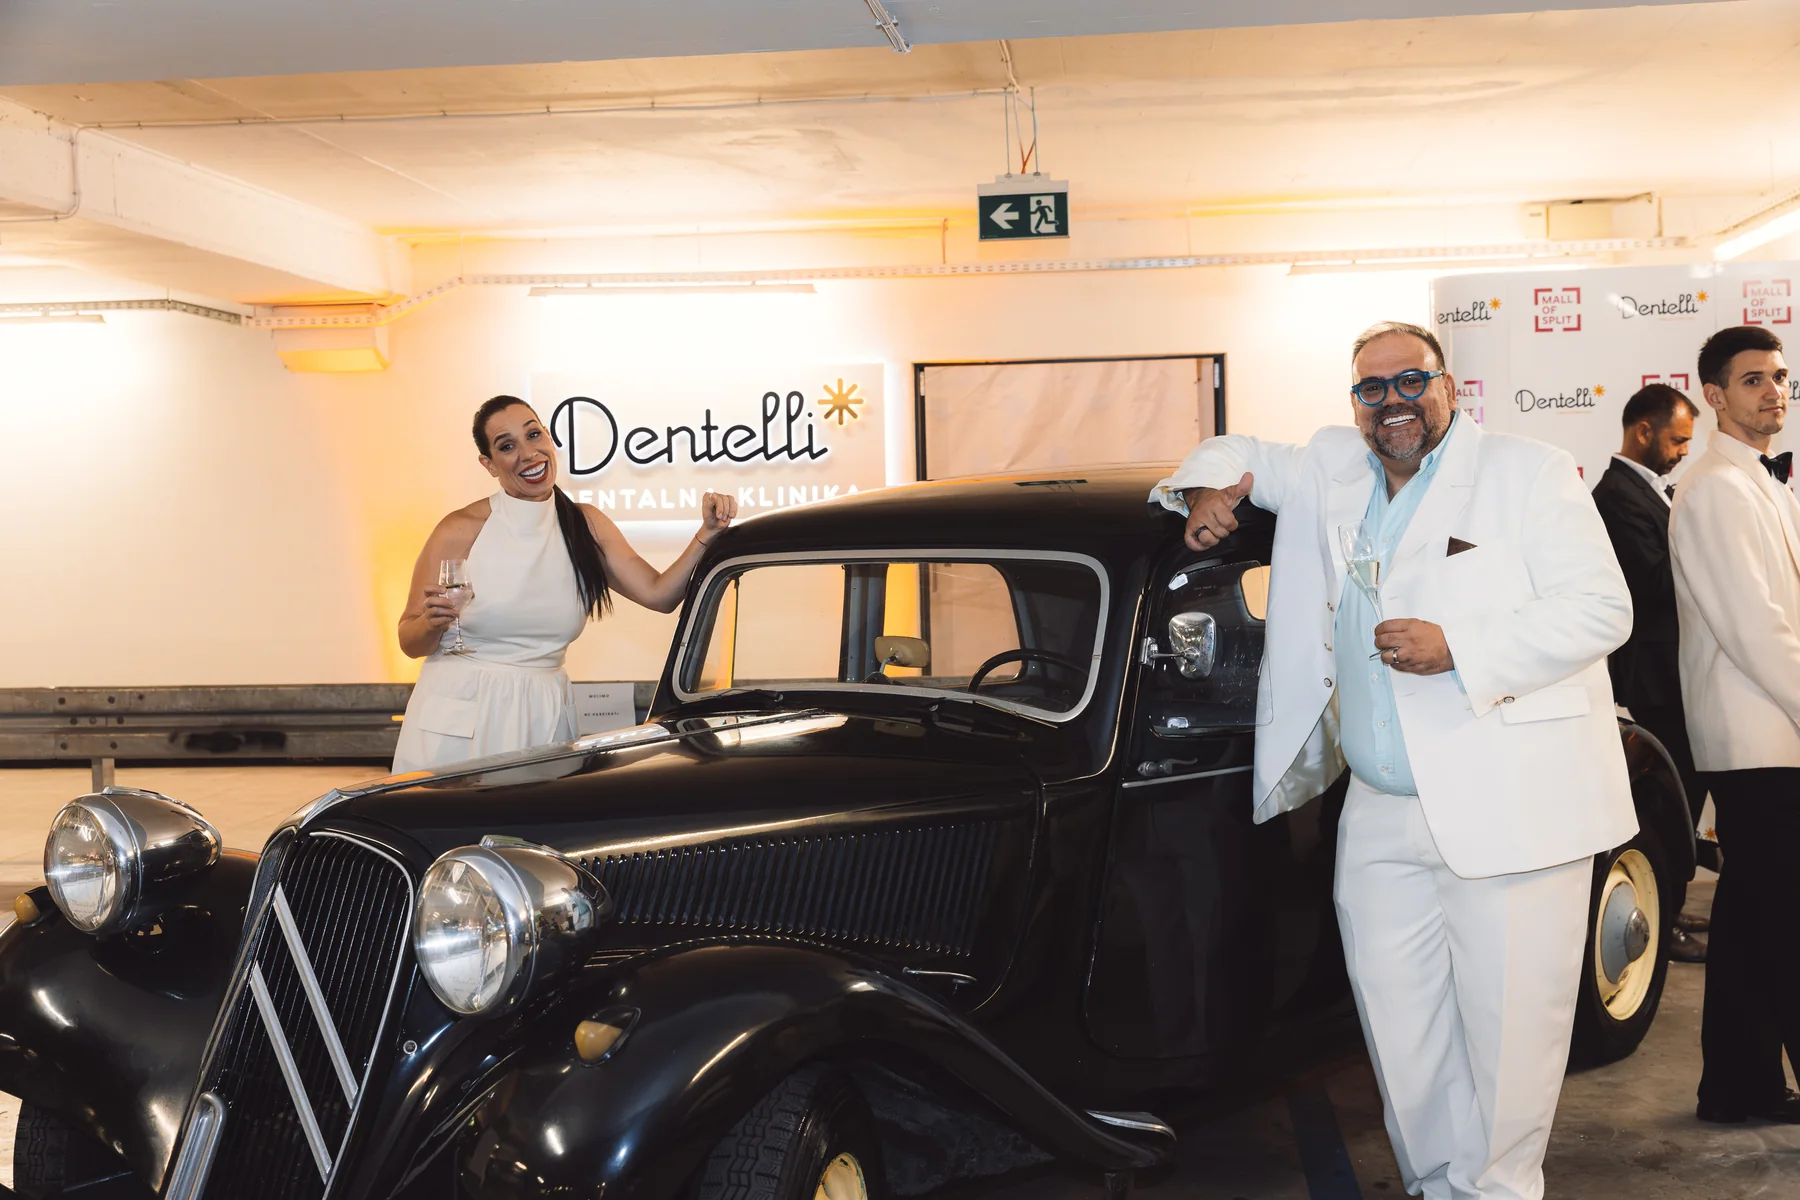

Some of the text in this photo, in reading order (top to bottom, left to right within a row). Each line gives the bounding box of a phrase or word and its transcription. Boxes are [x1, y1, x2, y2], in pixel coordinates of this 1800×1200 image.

[1750, 287, 1783, 297] MALL
[1541, 295, 1573, 305] MALL
[1750, 298, 1766, 307] OF
[1541, 305, 1557, 315] OF
[1617, 293, 1698, 319] Dentelli
[1437, 301, 1492, 325] entelli
[1750, 307, 1783, 318] SPLIT
[1541, 315, 1572, 325] SPLIT
[1456, 387, 1475, 397] ALL
[1515, 387, 1595, 413] Dentelli
[549, 390, 828, 476] Dentelli
[563, 486, 715, 510] ENTALN
